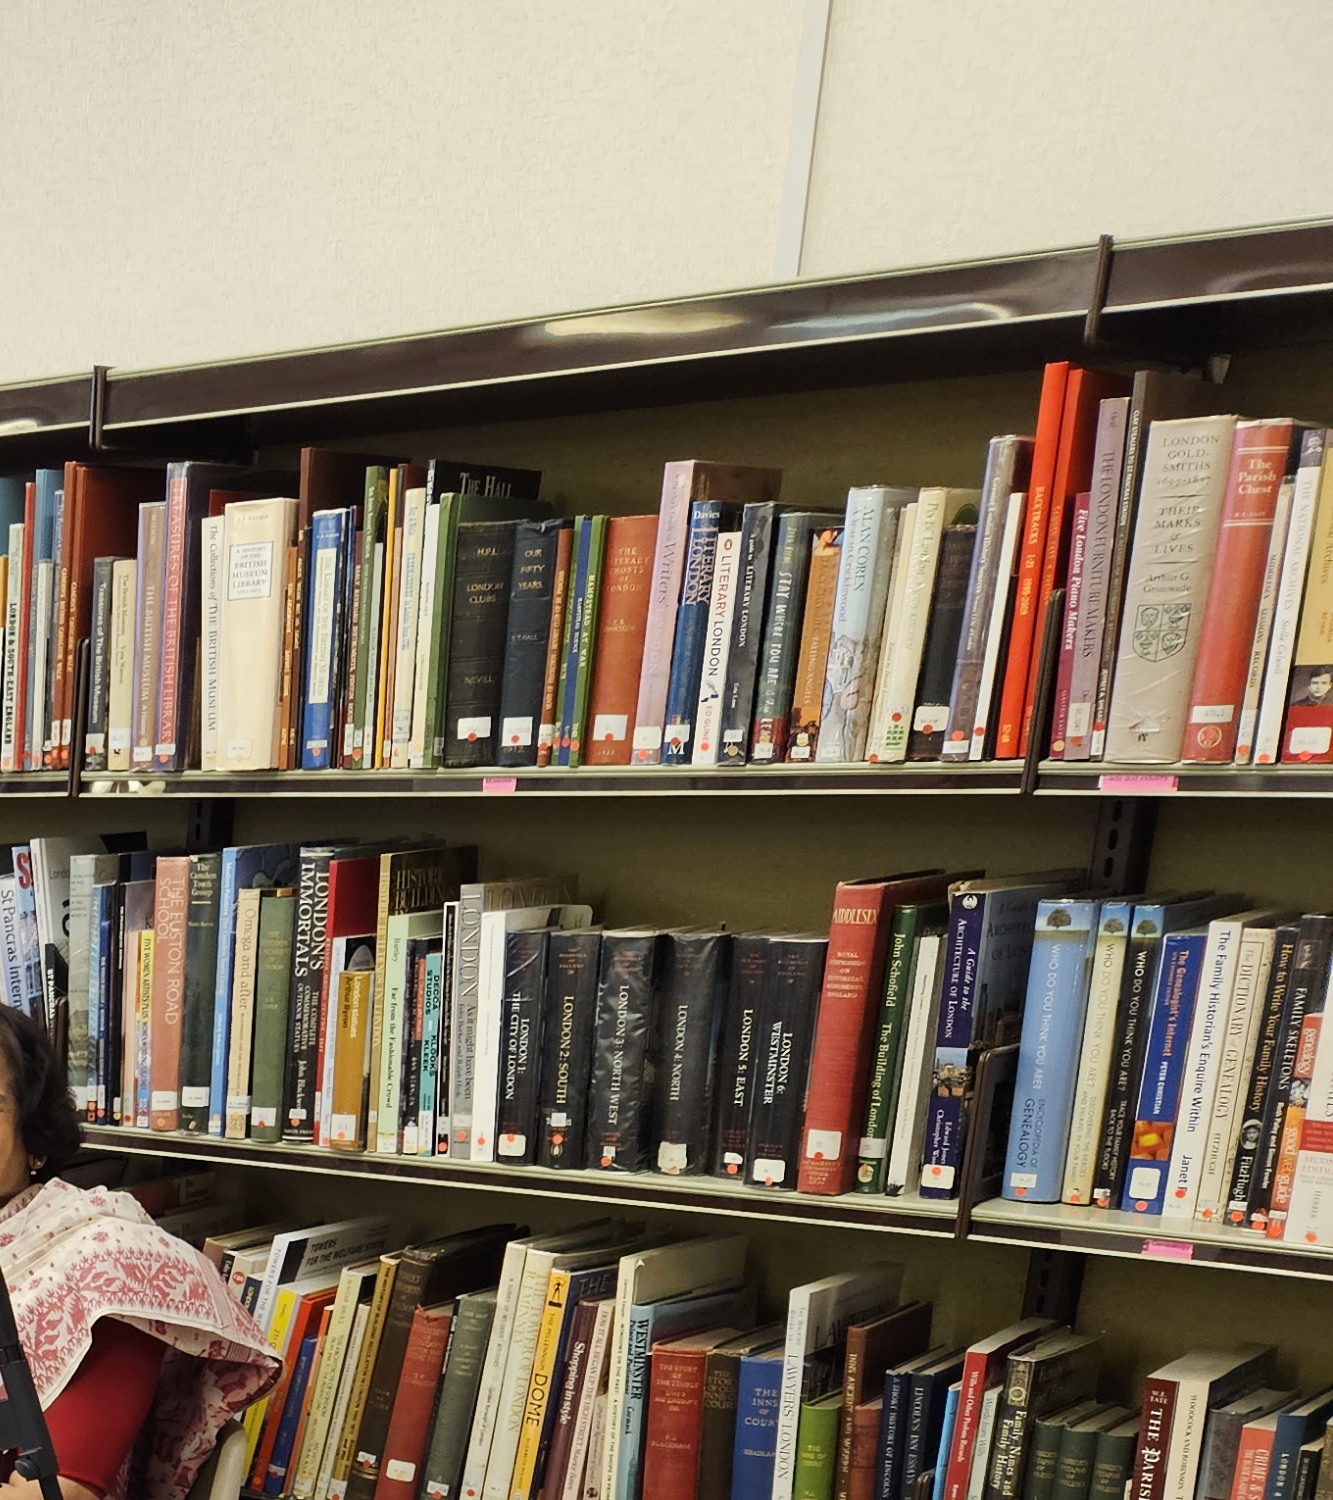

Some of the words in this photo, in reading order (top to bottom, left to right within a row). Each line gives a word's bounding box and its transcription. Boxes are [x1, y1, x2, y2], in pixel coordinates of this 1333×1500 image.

[1162, 435, 1220, 447] LONDON
[1167, 449, 1210, 459] GOLD-
[1163, 461, 1211, 473] SMITHS
[1238, 471, 1276, 483] Parish
[1247, 459, 1272, 470] The
[1238, 483, 1273, 495] Chest
[169, 487, 183, 577] TREASURES
[694, 510, 720, 521] Davies
[858, 506, 873, 540] ALAN
[1076, 509, 1087, 529] Five
[235, 560, 267, 569] BRITISH
[520, 564, 545, 574] FIFTY
[524, 549, 543, 557] OUR
[852, 545, 868, 592] COREN
[1072, 532, 1085, 572] London
[168, 579, 179, 594] OF
[232, 569, 268, 579] MUSEUM
[233, 579, 267, 589] LIBRARY
[518, 581, 544, 589] YEARS.
[686, 538, 702, 605] LONDON
[715, 555, 732, 618] LITERARY
[97, 583, 106, 623] Treasures
[1069, 575, 1081, 605] Piano
[167, 601, 178, 626] THE
[1065, 608, 1078, 650] Makers
[95, 636, 103, 653] The
[164, 631, 177, 685] BRITISH
[708, 621, 725, 677] LONDON
[94, 655, 102, 683] British
[91, 684, 101, 724] Museum
[1, 890, 14, 905] St
[173, 877, 186, 909] THE
[155, 878, 171, 943] SCHOOL
[295, 863, 315, 977] IMMORTALS
[310, 872, 330, 970] LONDON'S
[2, 906, 18, 963] Pancras
[169, 912, 184, 974] EUSTON
[241, 909, 256, 949] Omega
[461, 894, 481, 997] LONDON
[893, 933, 904, 958] John
[1218, 931, 1229, 950] The
[240, 957, 252, 979] and
[1134, 952, 1147, 976] WHO
[1181, 950, 1190, 962] The
[1210, 955, 1226, 988] Family
[1279, 944, 1292, 968] How
[886, 961, 901, 1007] Schofield
[949, 986, 958, 997] OF
[1132, 979, 1143, 993] DO
[1276, 971, 1287, 981] to
[166, 979, 180, 1025] ROAD
[237, 982, 251, 1010] after
[512, 992, 521, 1010] THE
[616, 985, 628, 1035] LONDON
[1128, 995, 1140, 1016] YOU
[1229, 965, 1253, 1036] DICTIONARY
[1270, 985, 1284, 1012] Write
[1290, 988, 1306, 1027] FAMILY
[510, 1015, 519, 1035] CITY
[561, 996, 573, 1048] LONDON
[675, 1005, 688, 1050] LONDON
[738, 1010, 752, 1062] LONDON
[880, 1024, 891, 1042] The
[945, 1000, 957, 1039] LONDON
[1124, 1017, 1137, 1044] THINK
[1201, 993, 1219, 1049] Historian's
[1265, 1014, 1278, 1037] Your
[429, 1035, 437, 1076] KLOOKS
[509, 1037, 518, 1051] OF
[518, 1018, 529, 1061] LONDON
[560, 1051, 569, 1061] 2:
[778, 1032, 792, 1079] LONDON
[1163, 1022, 1177, 1056] Internet
[1295, 1028, 1316, 1074] genealogy
[517, 1063, 526, 1074] 1:
[611, 1051, 623, 1090] NORTH
[764, 1022, 781, 1105] WESTMINSTER
[873, 1046, 889, 1088] Building
[1121, 1046, 1133, 1067] YOU
[1194, 1053, 1209, 1089] Enquire
[1257, 1040, 1273, 1075] Family
[1277, 1029, 1298, 1091] SKELETONS
[506, 1053, 517, 1099] LONDON
[557, 1063, 568, 1104] SOUTH
[671, 1064, 682, 1100] NORTH
[734, 1078, 745, 1107] EAST
[1117, 1070, 1129, 1091] ARE?
[1217, 1049, 1236, 1120] GENEALOGY
[609, 1092, 619, 1125] WEST
[1187, 1091, 1202, 1132] Within
[1249, 1078, 1266, 1112] History
[1016, 1099, 1034, 1168] GENEALOGY
[565, 1341, 585, 1390] Shopping
[633, 1319, 649, 1399] WESTMINSTER
[526, 1374, 548, 1427] DOME
[559, 1403, 572, 1424] style
[1147, 1409, 1163, 1441] THE
[778, 1423, 792, 1480] LONDON
